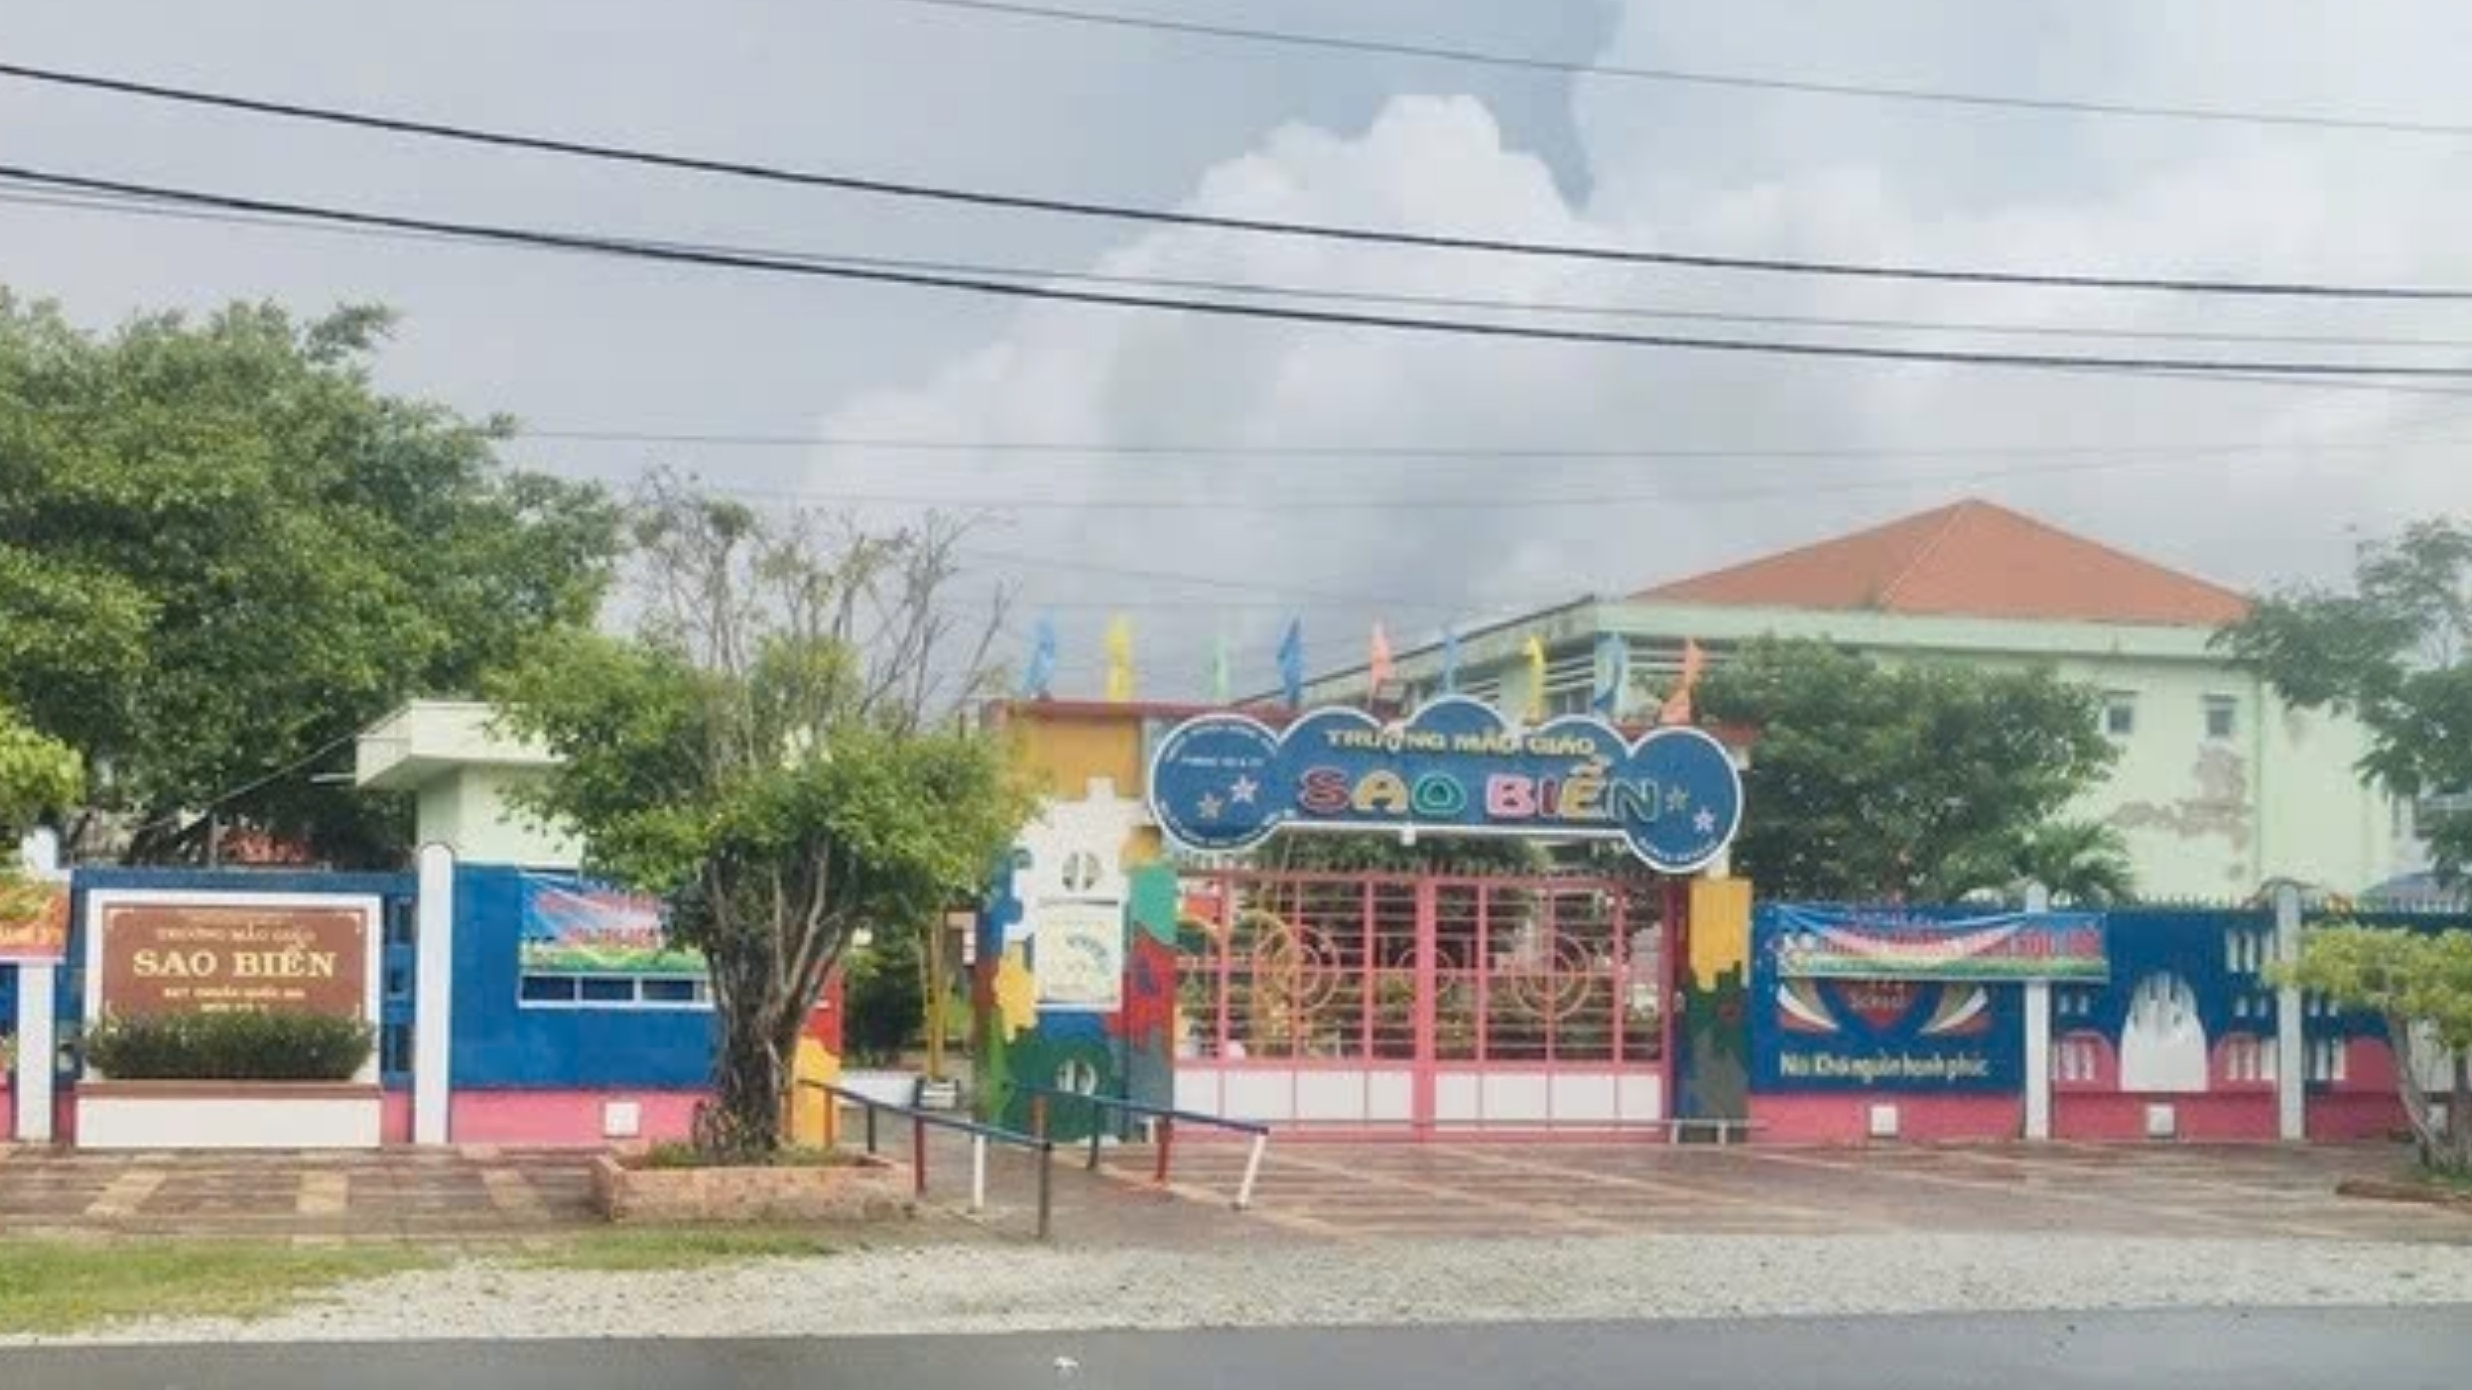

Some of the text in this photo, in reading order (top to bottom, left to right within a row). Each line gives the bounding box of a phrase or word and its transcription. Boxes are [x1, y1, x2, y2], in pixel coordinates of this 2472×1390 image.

[1302, 753, 1659, 822] SAO BIỂN
[133, 938, 337, 978] SAO BIỂN
